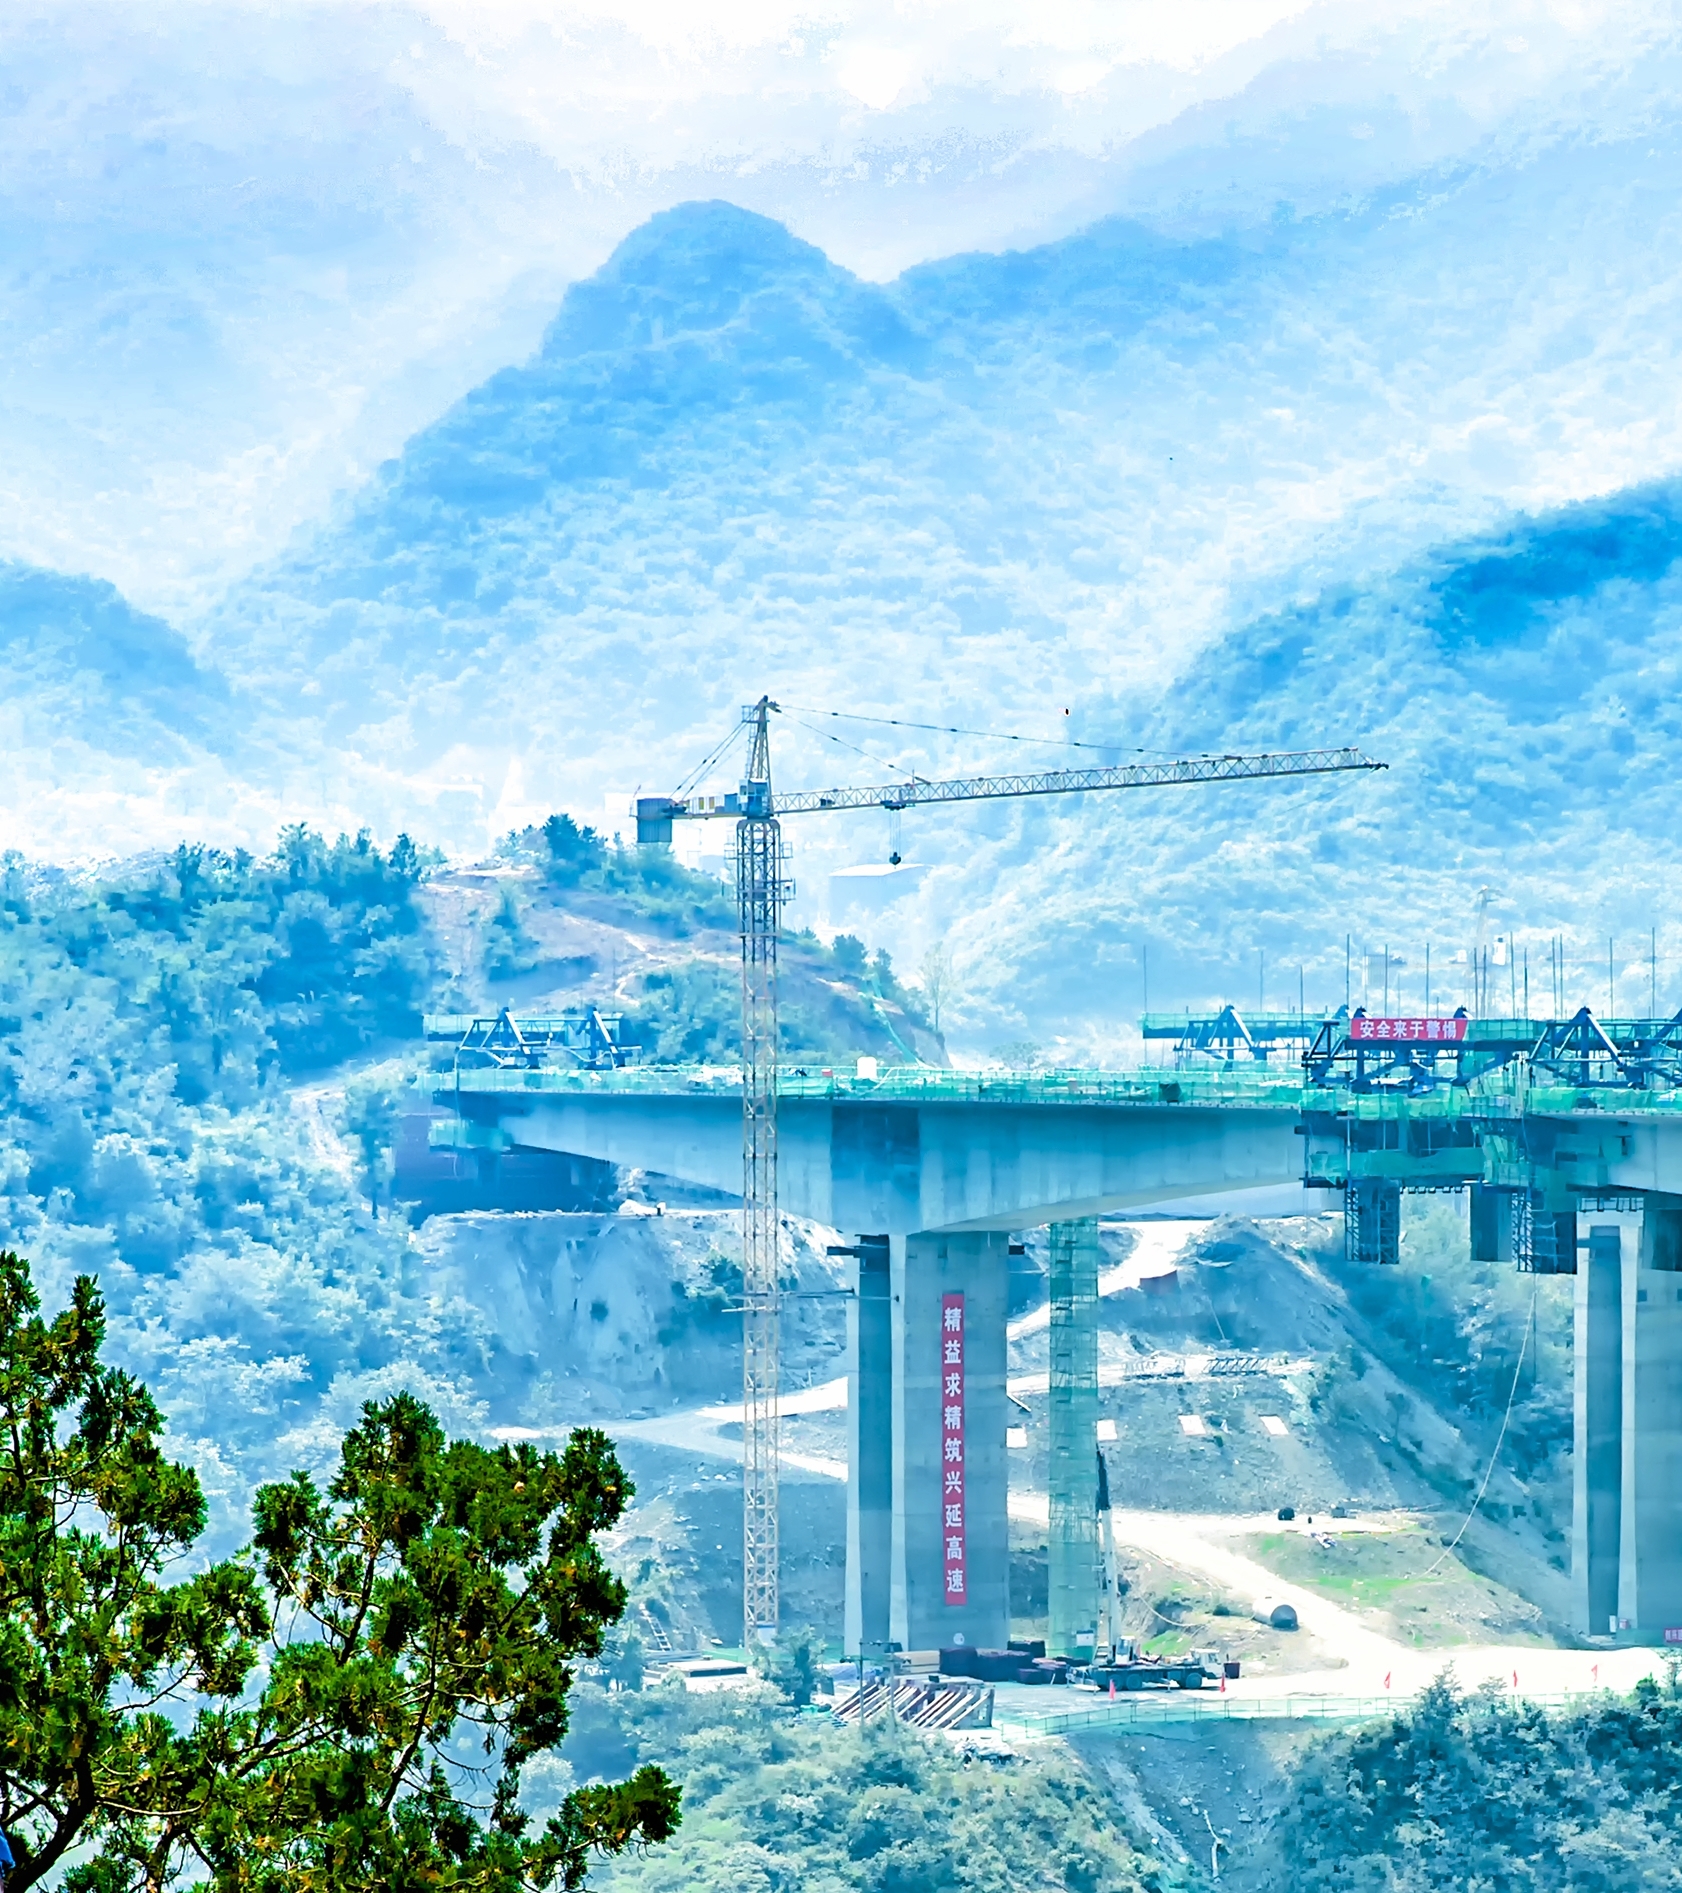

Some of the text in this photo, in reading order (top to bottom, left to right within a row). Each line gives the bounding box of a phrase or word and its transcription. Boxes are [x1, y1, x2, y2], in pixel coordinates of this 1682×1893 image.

[1360, 1020, 1456, 1038] 安全来于警惕
[944, 1307, 964, 1593] 精益求精筑兴延高速
